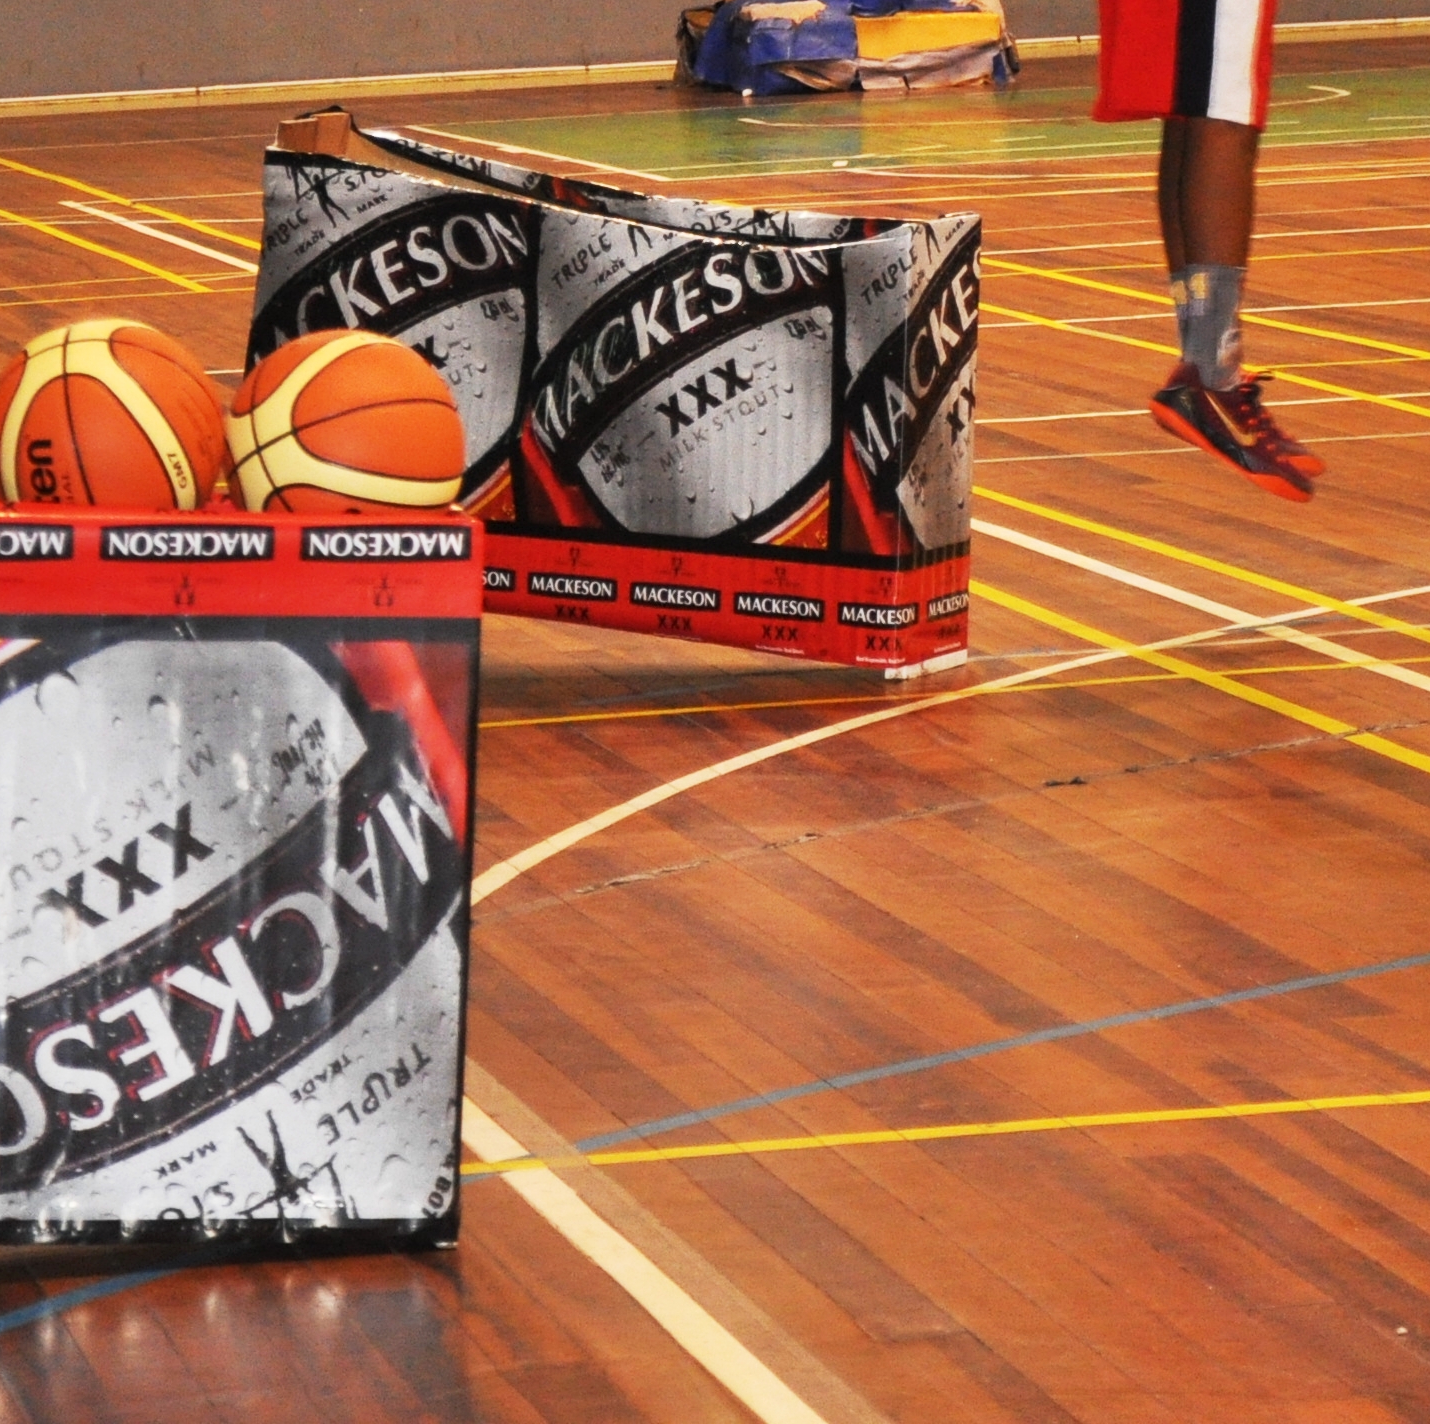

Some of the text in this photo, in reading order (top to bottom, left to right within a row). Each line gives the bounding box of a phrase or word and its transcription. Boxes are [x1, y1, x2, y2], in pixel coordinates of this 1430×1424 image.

[531, 248, 829, 454] MACKESON
[654, 357, 753, 439] XXX
[167, 451, 188, 490] GM7
[107, 528, 268, 559] MACKESON
[307, 529, 466, 560] MACKESON
[531, 574, 613, 598] MACKESON
[633, 585, 717, 608] MACKESON
[736, 593, 821, 618] MACKESON
[841, 605, 917, 625] MACKESON
[762, 625, 799, 641] XXX
[36, 800, 216, 929] XXX
[152, 1053, 353, 1180] TRADE MARK
